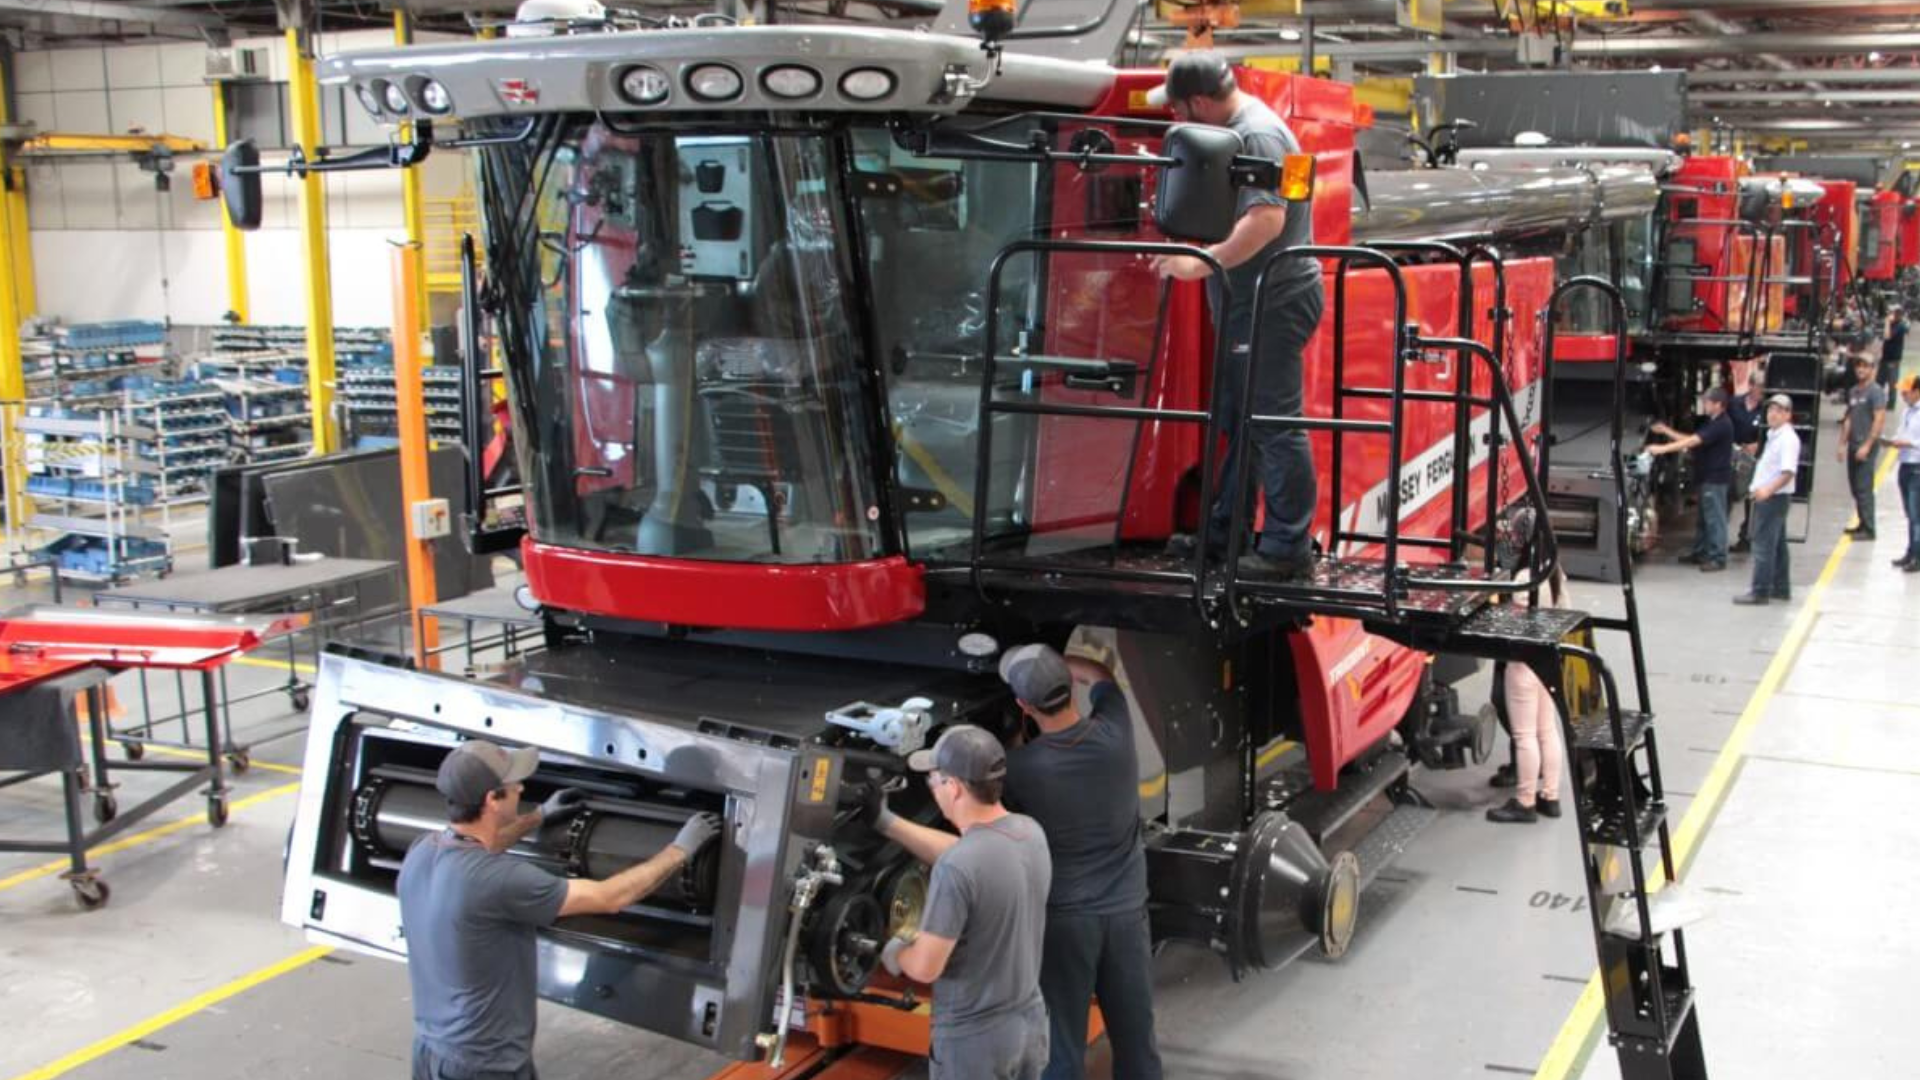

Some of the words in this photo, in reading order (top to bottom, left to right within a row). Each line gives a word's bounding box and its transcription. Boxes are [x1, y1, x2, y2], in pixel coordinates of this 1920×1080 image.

[1377, 468, 1421, 523] MSEY
[1426, 434, 1476, 488] FERGN
[1528, 890, 1587, 912] 140
